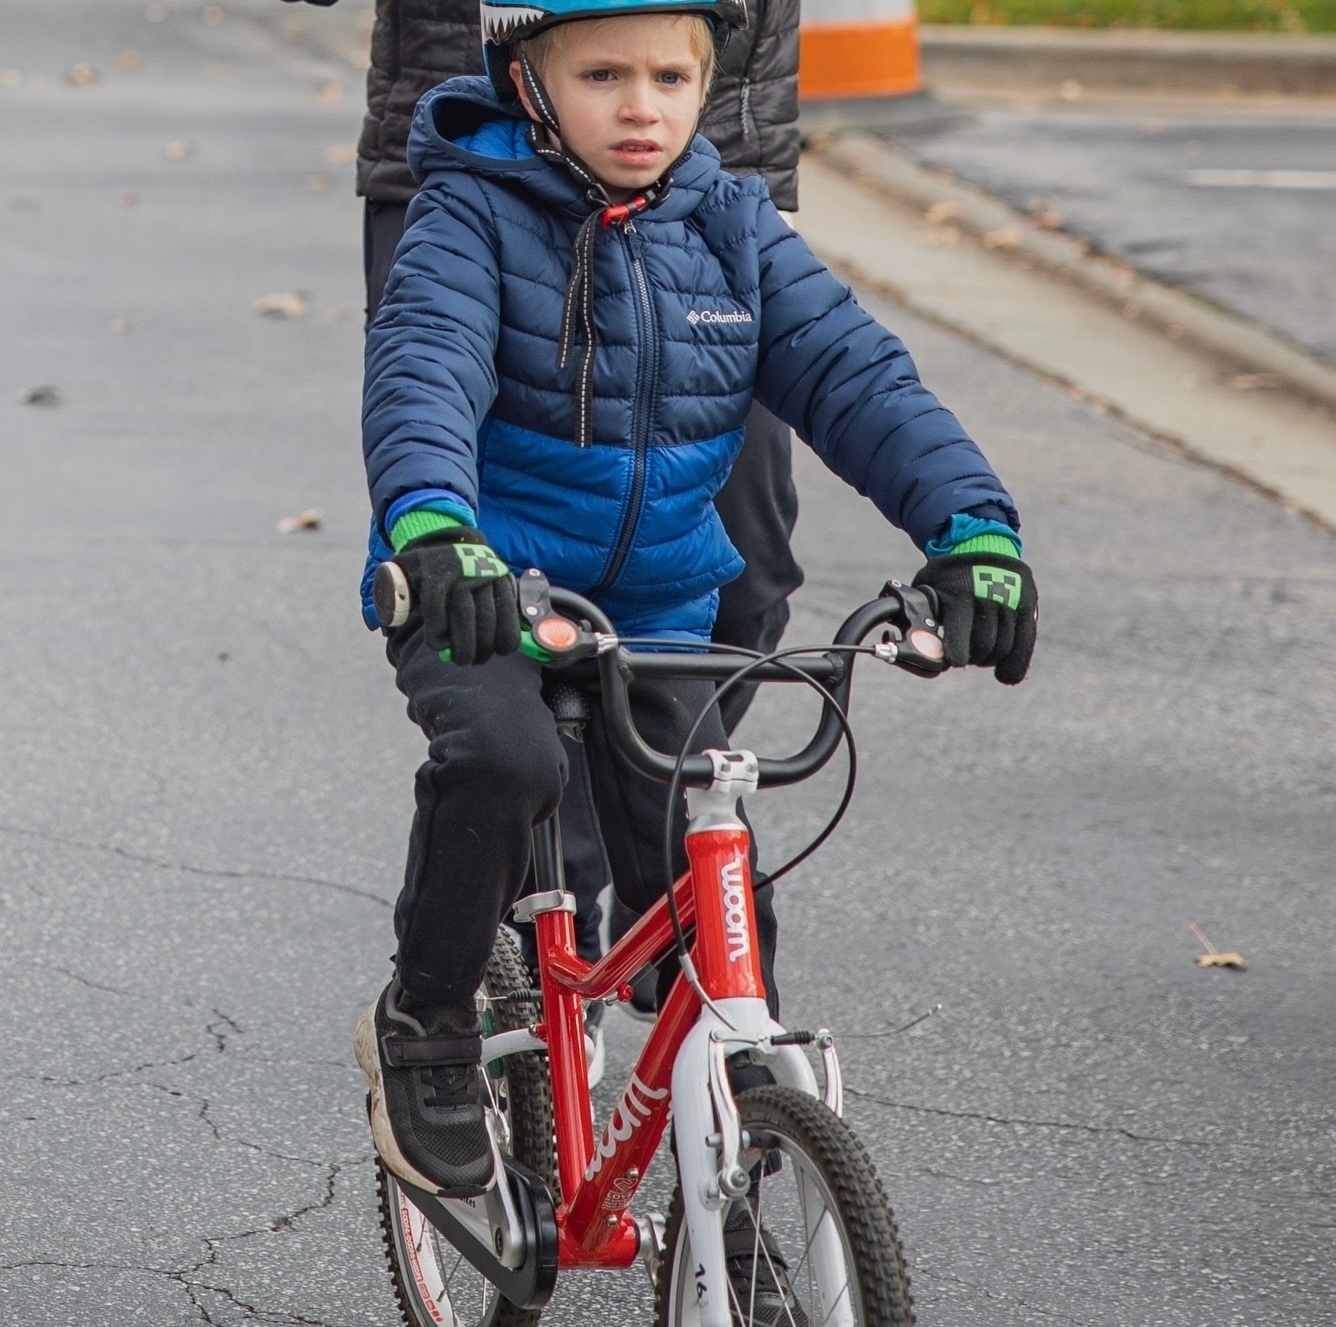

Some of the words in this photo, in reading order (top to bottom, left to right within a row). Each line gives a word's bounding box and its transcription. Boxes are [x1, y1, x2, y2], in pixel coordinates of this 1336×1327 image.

[700, 310, 752, 323] Columbia
[720, 856, 749, 963] woom
[695, 1263, 708, 1300] 16
